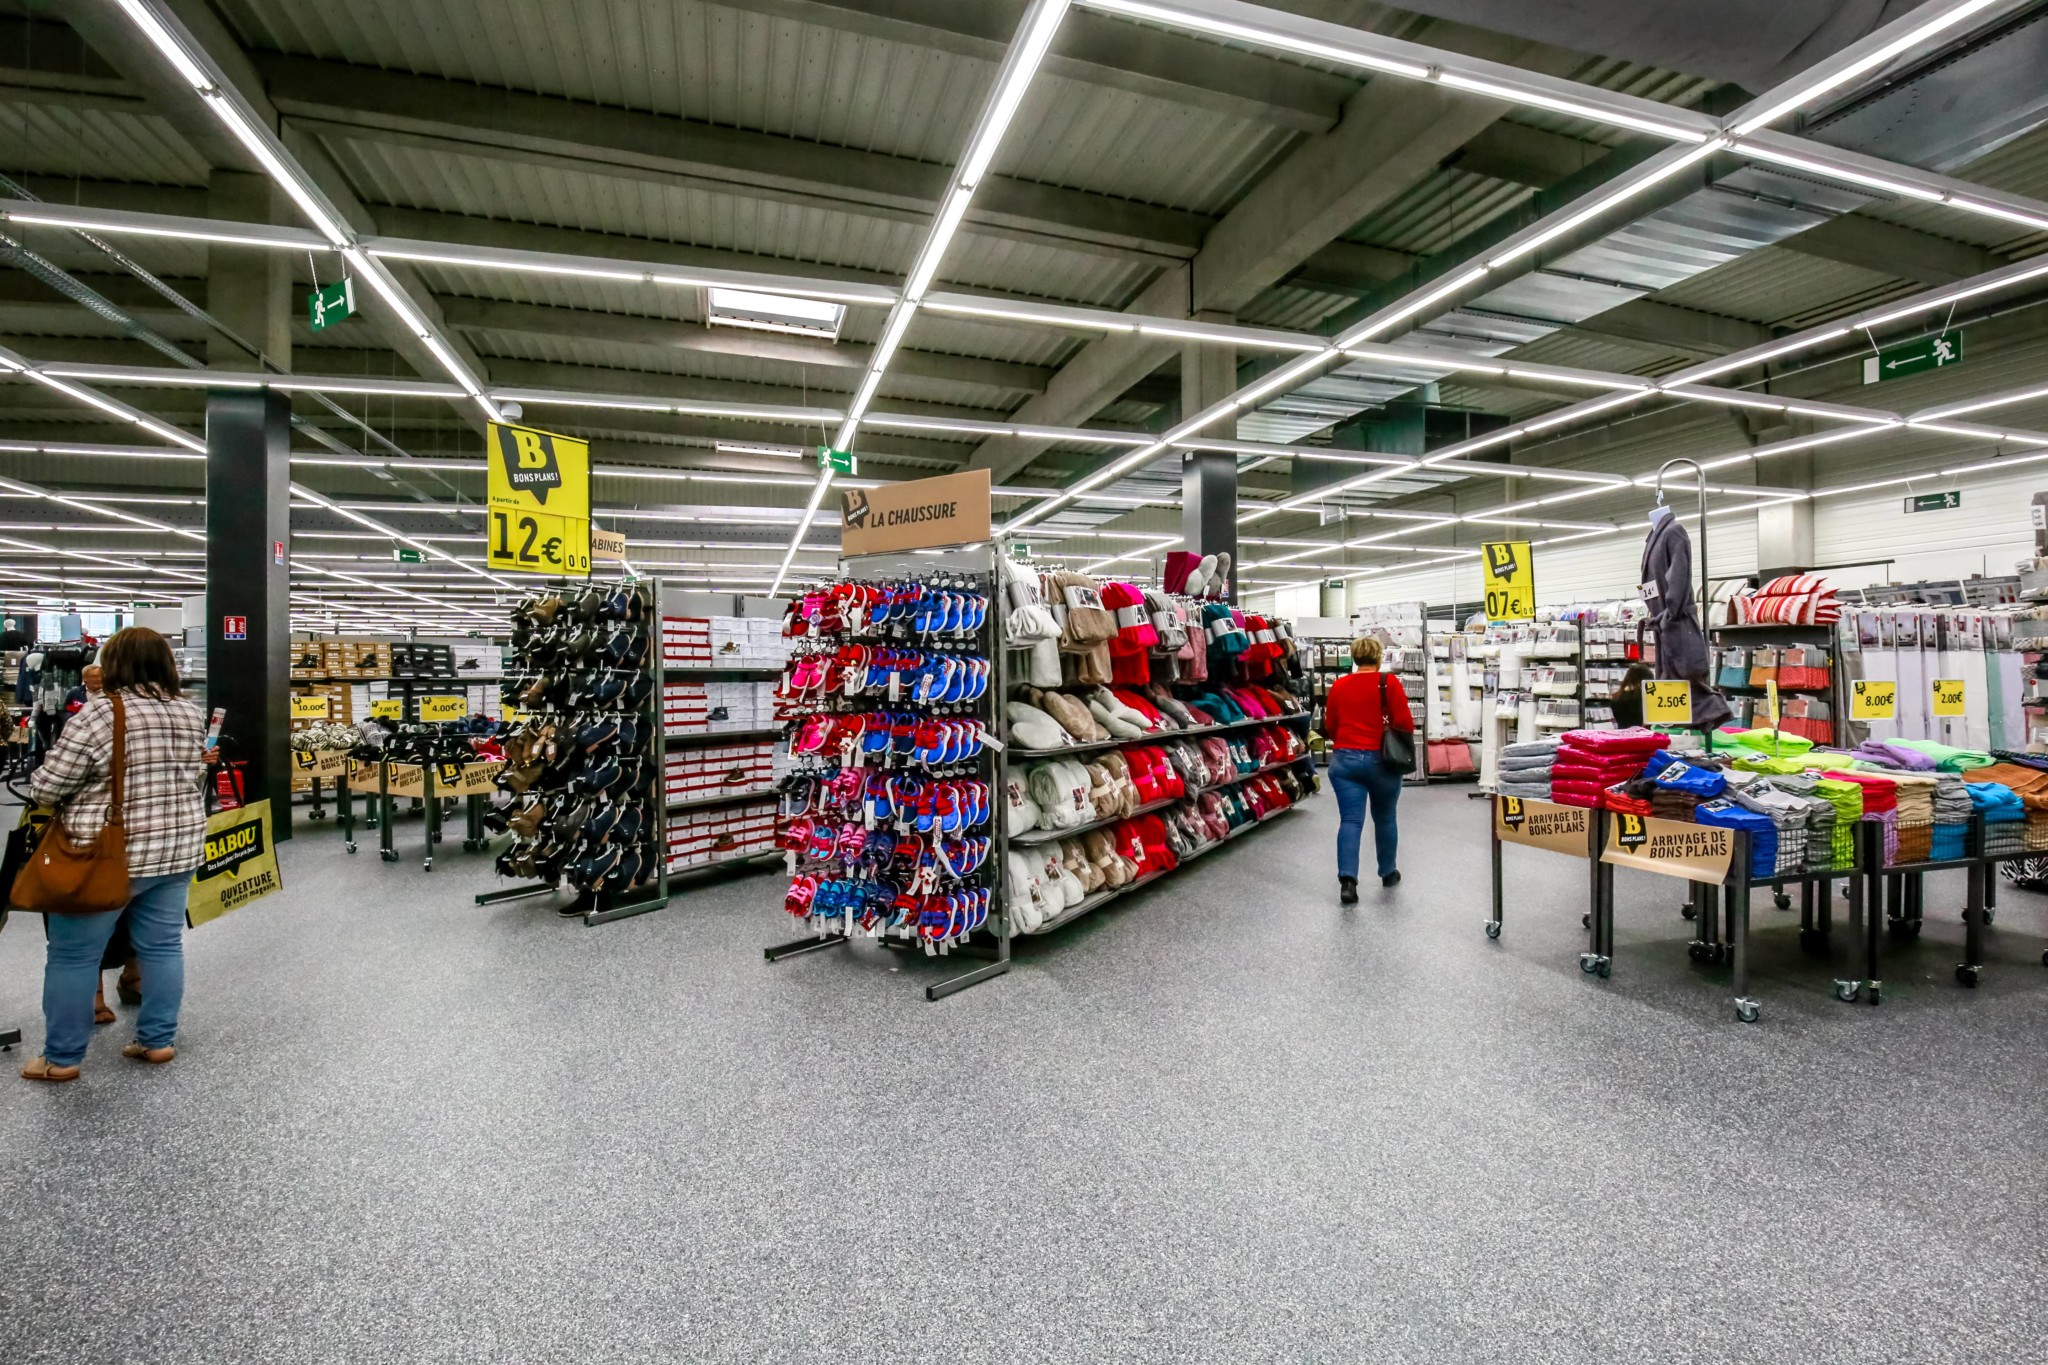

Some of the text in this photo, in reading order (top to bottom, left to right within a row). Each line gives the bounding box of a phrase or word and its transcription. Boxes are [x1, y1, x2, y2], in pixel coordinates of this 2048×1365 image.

[511, 429, 547, 468] B
[513, 472, 559, 483] BONS PLANS!
[870, 501, 957, 528] LA CHAUSSURE
[591, 538, 623, 553] ABINES
[1491, 544, 1510, 566] B
[1657, 693, 1687, 708] 2.50€
[1865, 692, 1894, 706] 8.00€
[1941, 692, 1962, 704] 2.00€
[298, 703, 326, 711] 10.00€
[432, 703, 457, 712] 4.00€
[321, 761, 340, 771] BONS
[465, 764, 499, 780] ARRIVAGE
[466, 776, 486, 788] BONS
[1508, 796, 1520, 814] B
[1528, 810, 1584, 825] ARRIVAGE DE
[1625, 814, 1641, 835] B
[1529, 820, 1585, 836] BONS PLANS
[204, 825, 256, 862] BABOU
[1651, 831, 1726, 847] ARRIVAGE DE
[1649, 843, 1728, 859] BONS PLANS
[220, 871, 273, 903] OUVERTURE
[224, 881, 277, 908] de votre magasin
